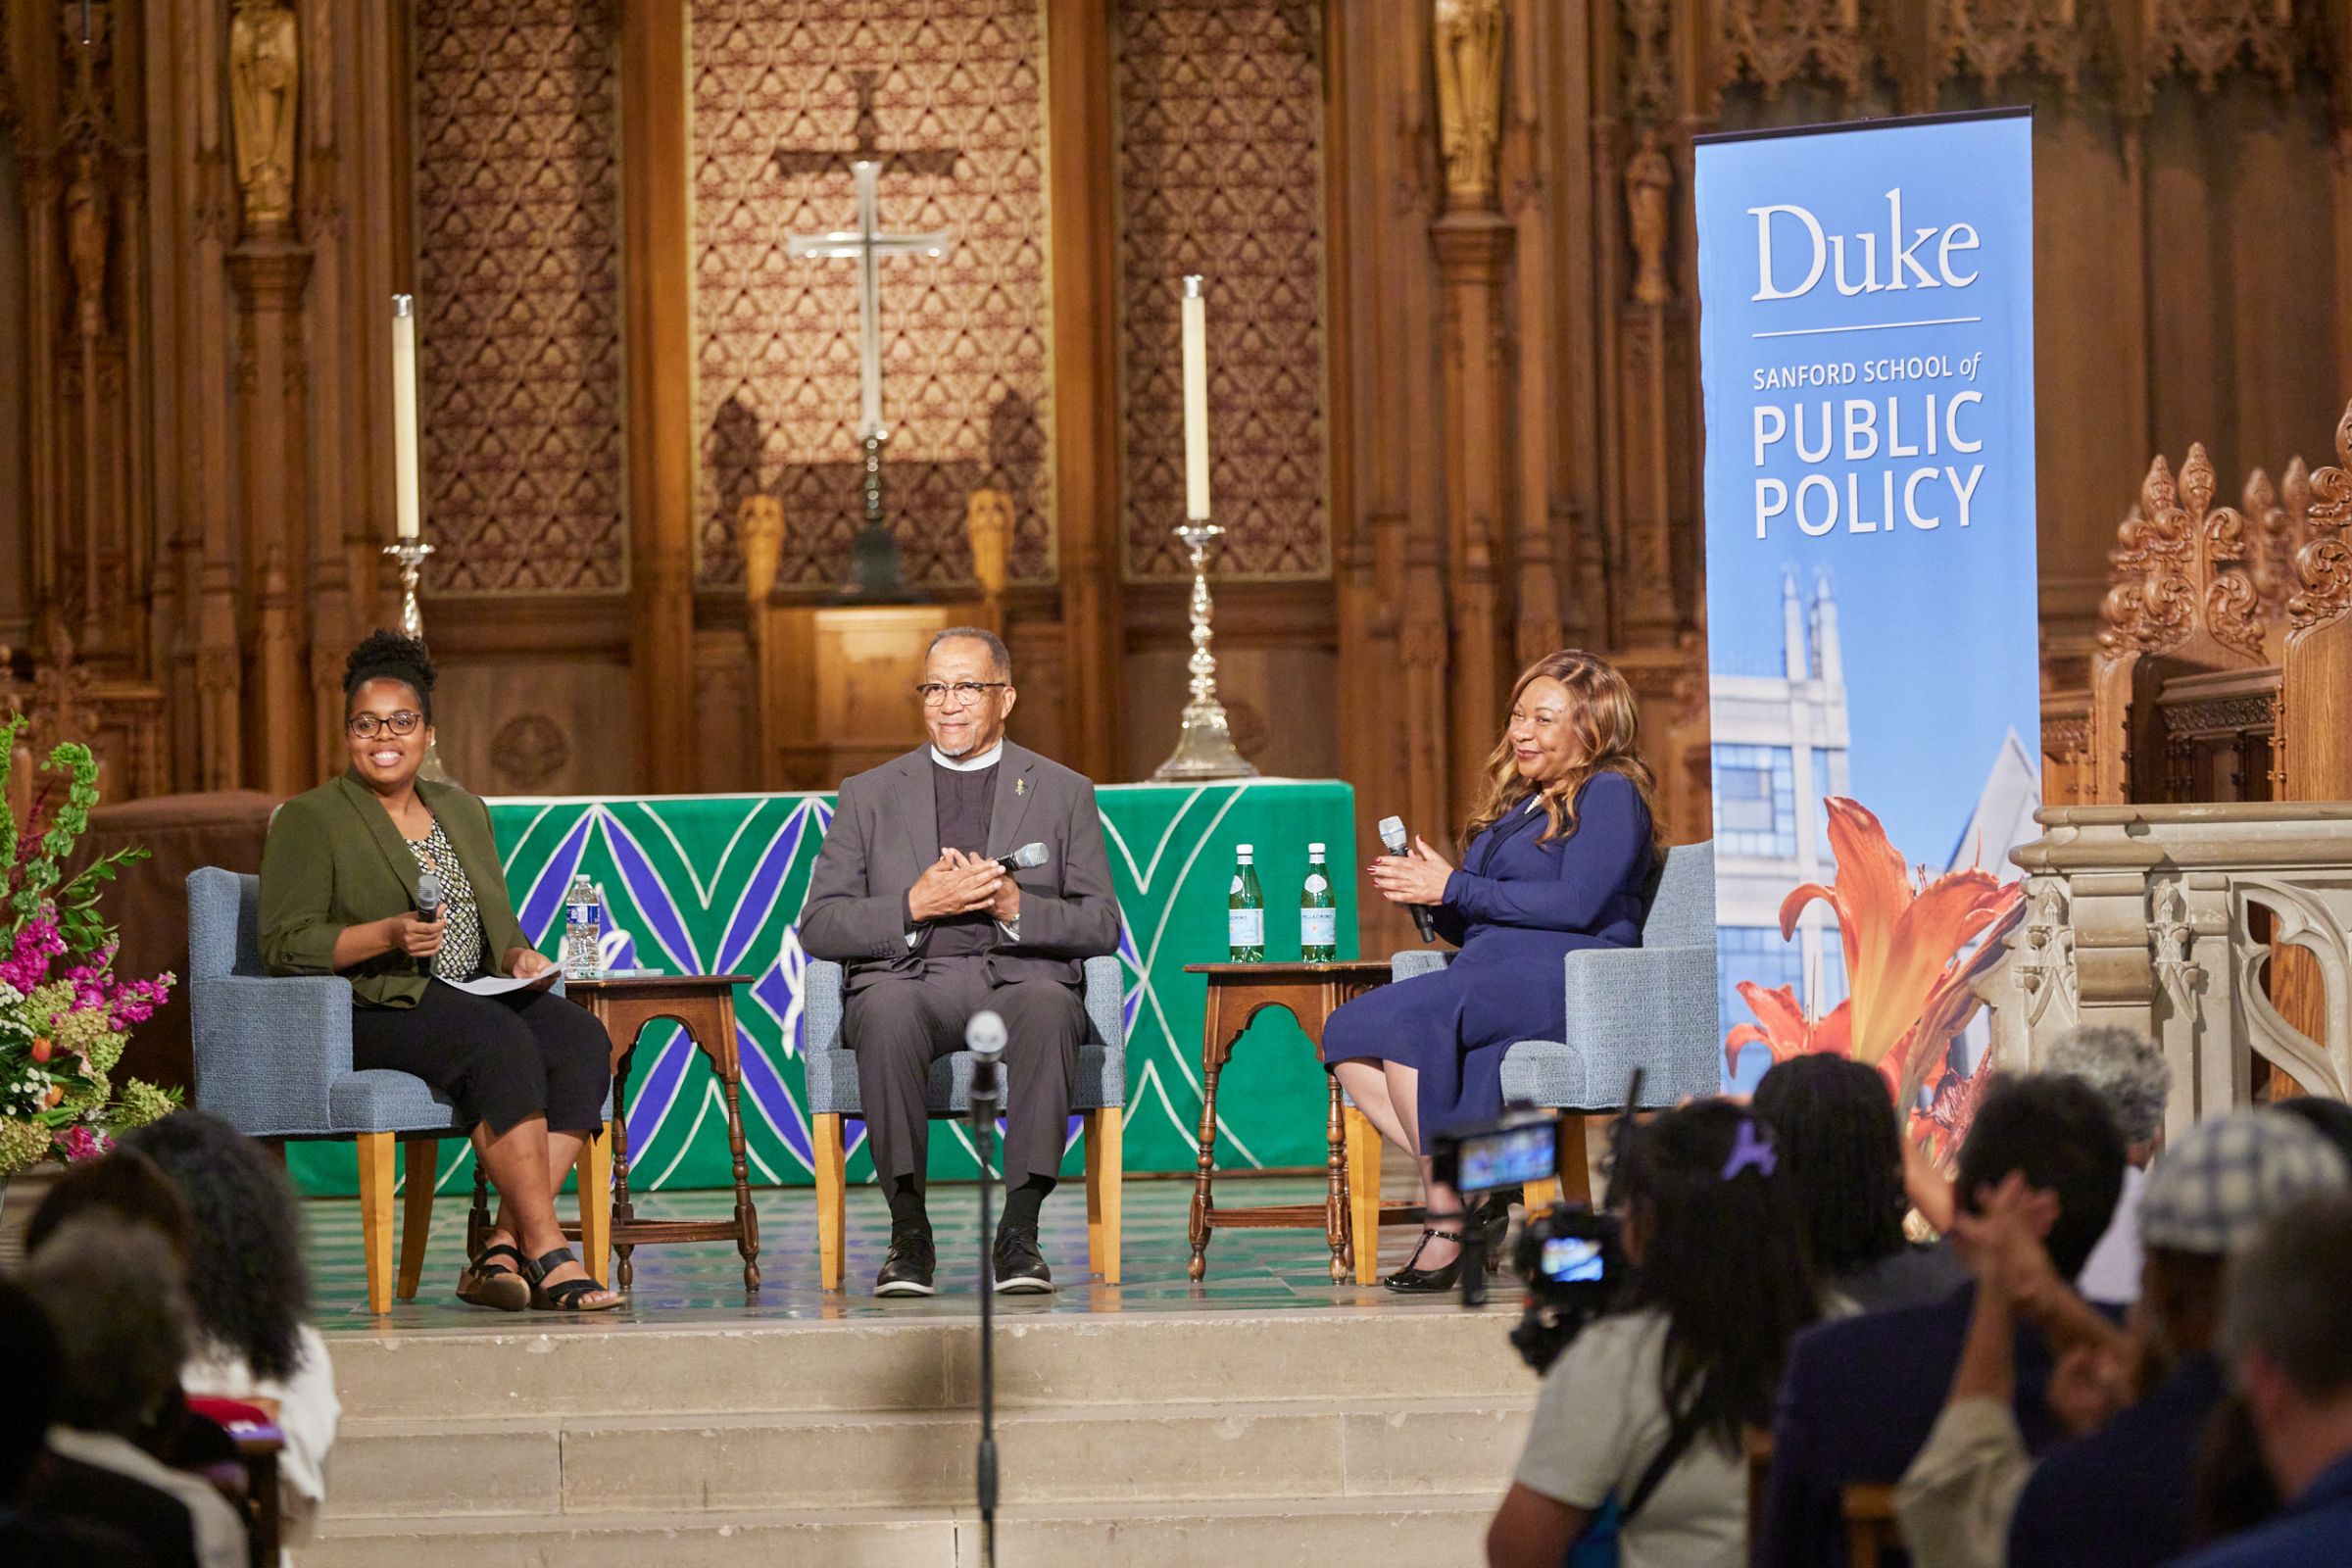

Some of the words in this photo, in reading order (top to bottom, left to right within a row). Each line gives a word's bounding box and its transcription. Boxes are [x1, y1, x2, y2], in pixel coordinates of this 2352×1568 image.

[1747, 187, 1981, 302] Duke
[1752, 362, 1857, 391] SANFORD
[1863, 355, 1953, 384] SCHOOL
[1959, 351, 1983, 381] of
[1753, 390, 1984, 467] PUBLIC
[1754, 464, 1985, 540] POLICY
